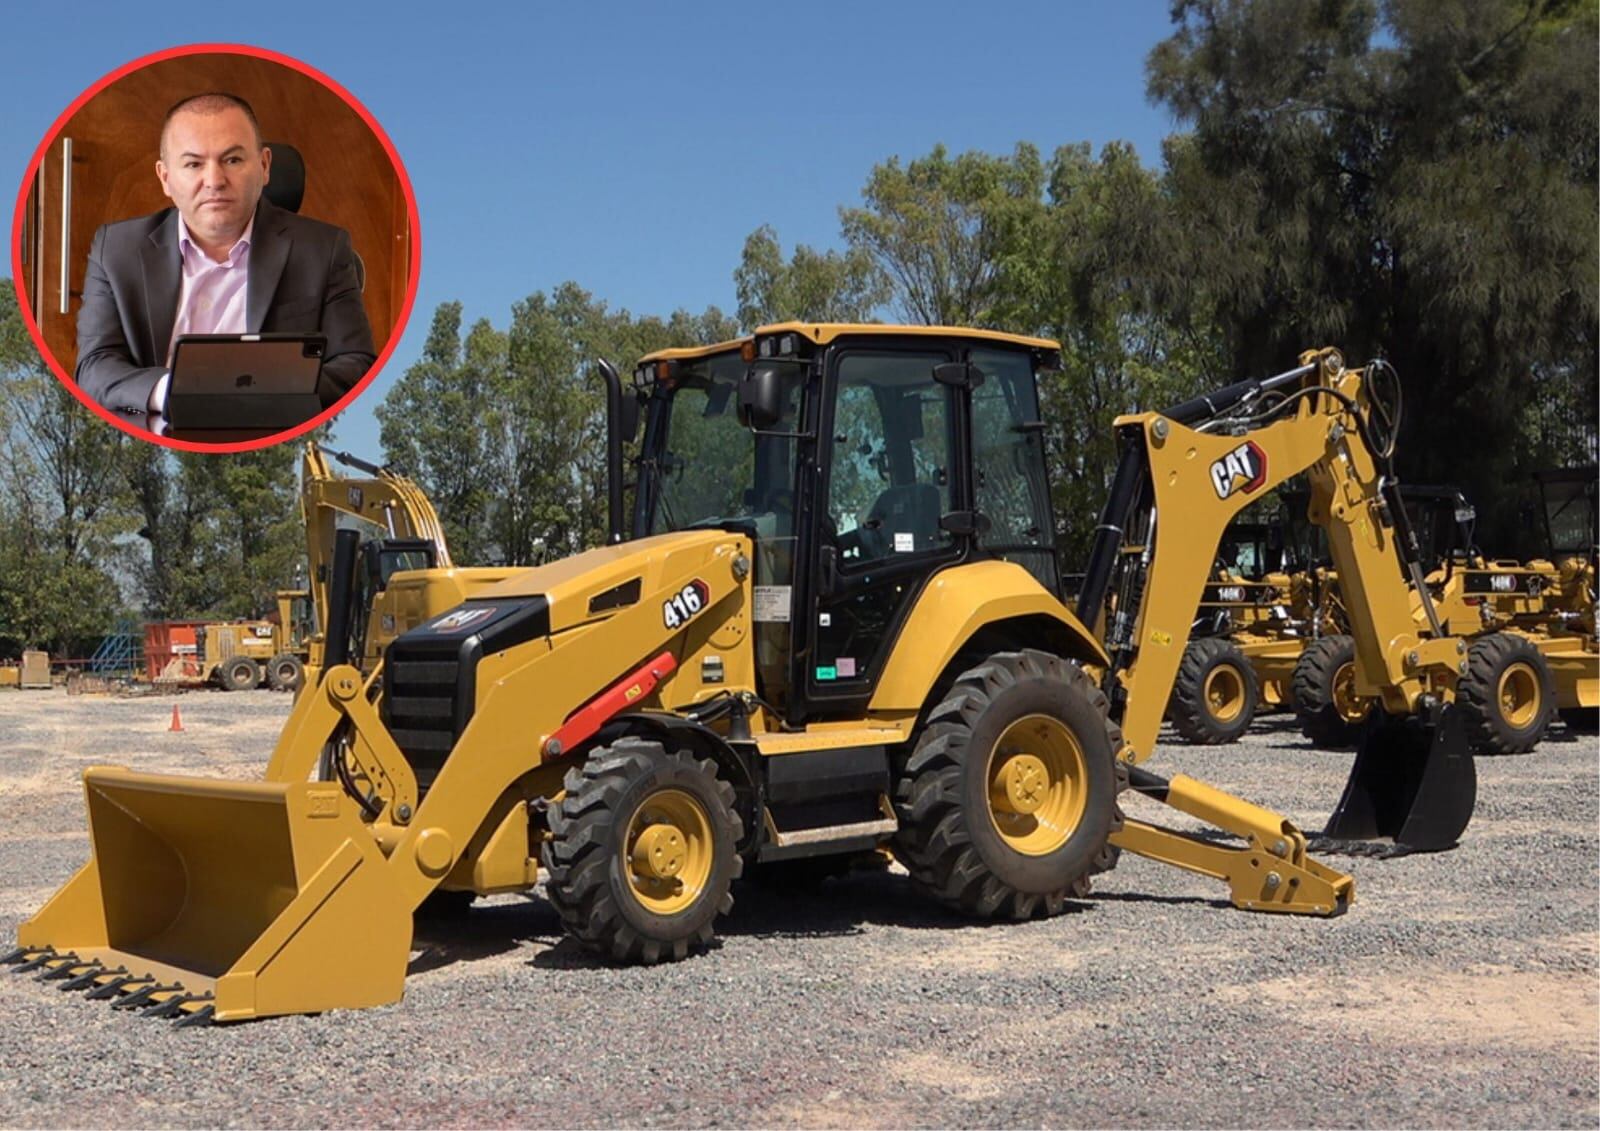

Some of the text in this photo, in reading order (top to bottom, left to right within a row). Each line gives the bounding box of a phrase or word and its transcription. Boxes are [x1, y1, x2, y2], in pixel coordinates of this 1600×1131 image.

[1211, 443, 1255, 498] CAT
[430, 608, 491, 629] CAT
[664, 585, 701, 627] 416
